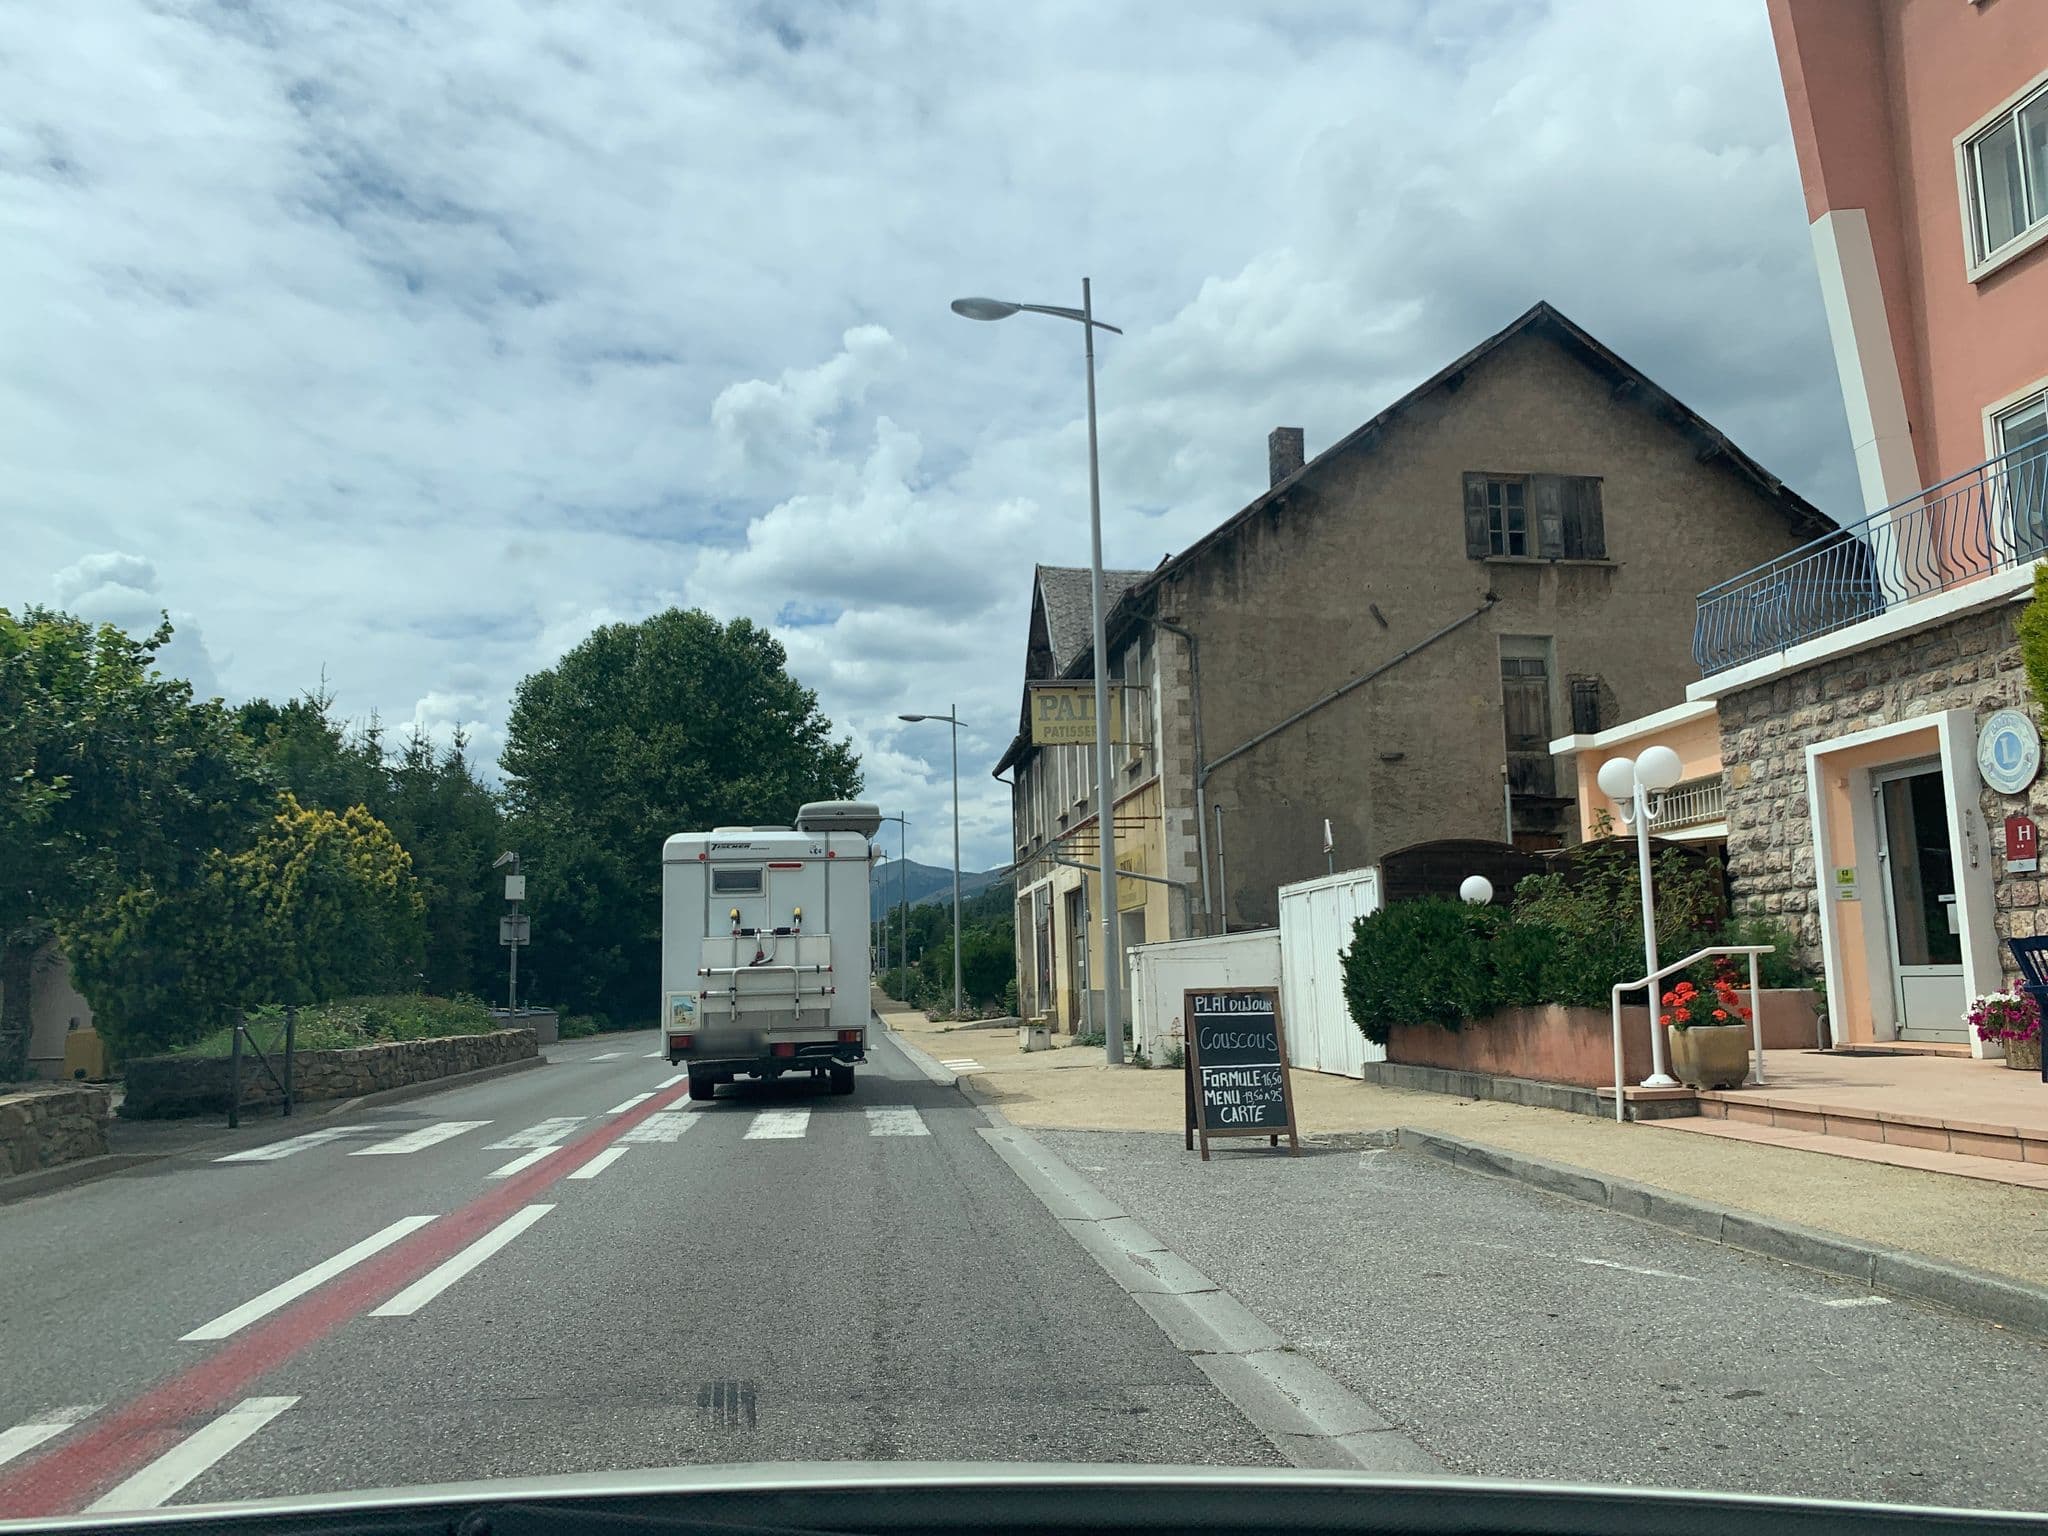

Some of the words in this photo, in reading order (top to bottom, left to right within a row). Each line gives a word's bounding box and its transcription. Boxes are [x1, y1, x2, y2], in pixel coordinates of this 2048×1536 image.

[2017, 824, 2031, 841] H
[1195, 995, 1228, 1012] PLAT
[1204, 1089, 1241, 1106] MENU
[1220, 1104, 1266, 1123] CARTE
